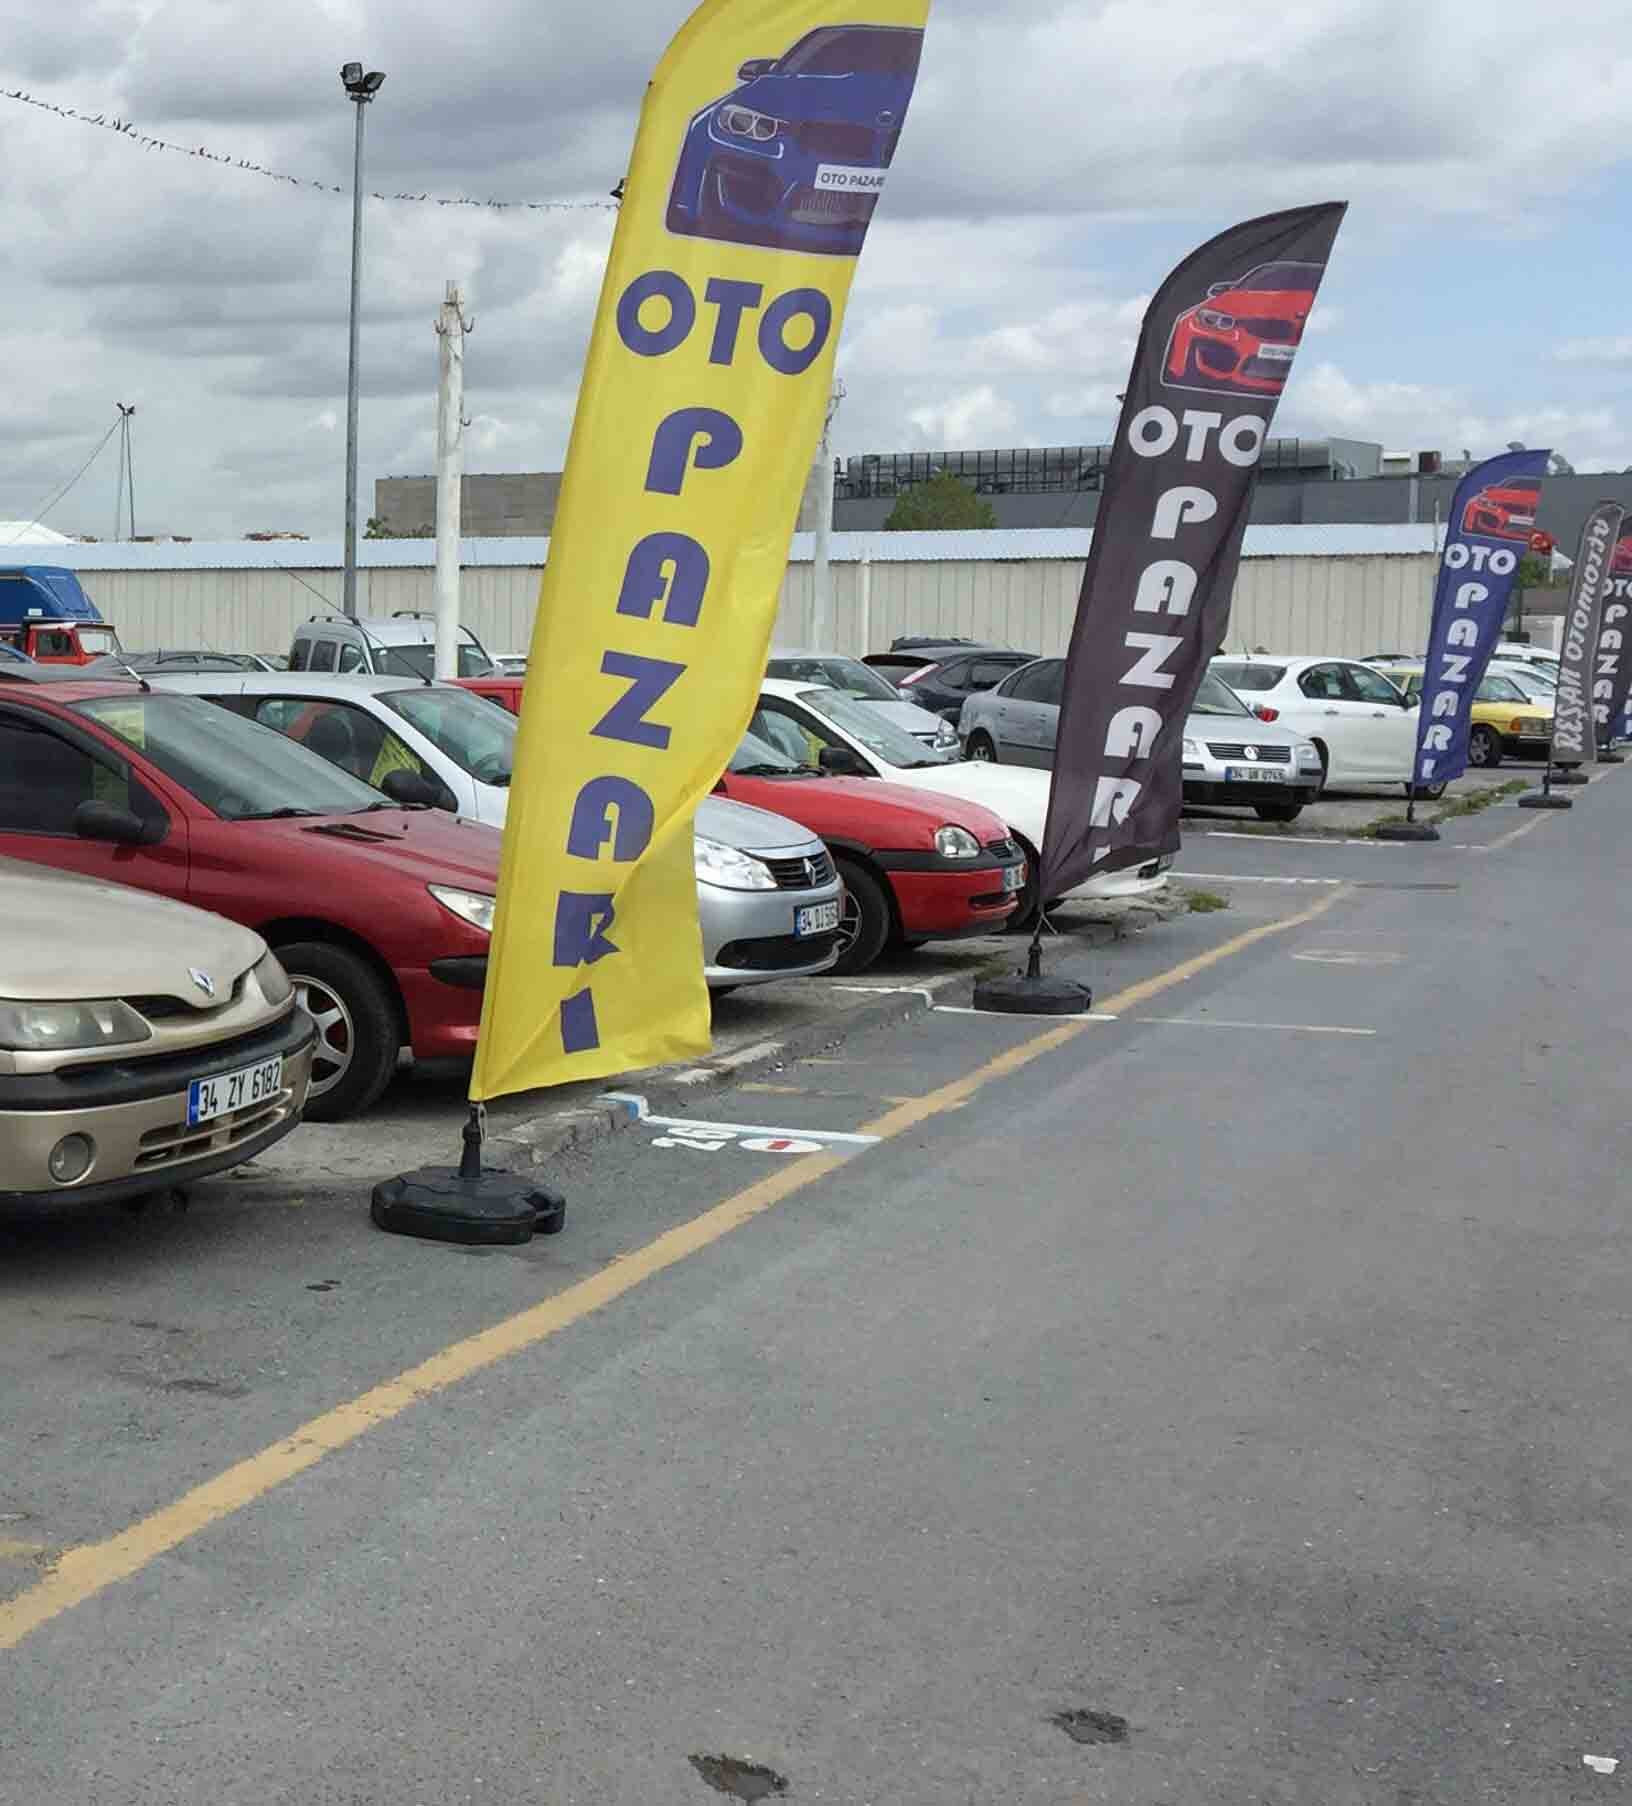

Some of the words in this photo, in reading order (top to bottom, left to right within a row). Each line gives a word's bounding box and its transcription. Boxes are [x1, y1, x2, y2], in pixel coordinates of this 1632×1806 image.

[821, 172, 847, 185] OTO
[849, 175, 885, 187] PAZAR
[616, 270, 832, 375] OTO
[1128, 405, 1266, 467] OTO
[1445, 543, 1517, 575] OTO
[1421, 581, 1490, 779] PAZARI
[552, 407, 743, 1054] PAZARI
[199, 1083, 218, 1116] 34
[227, 1073, 246, 1108] ZY
